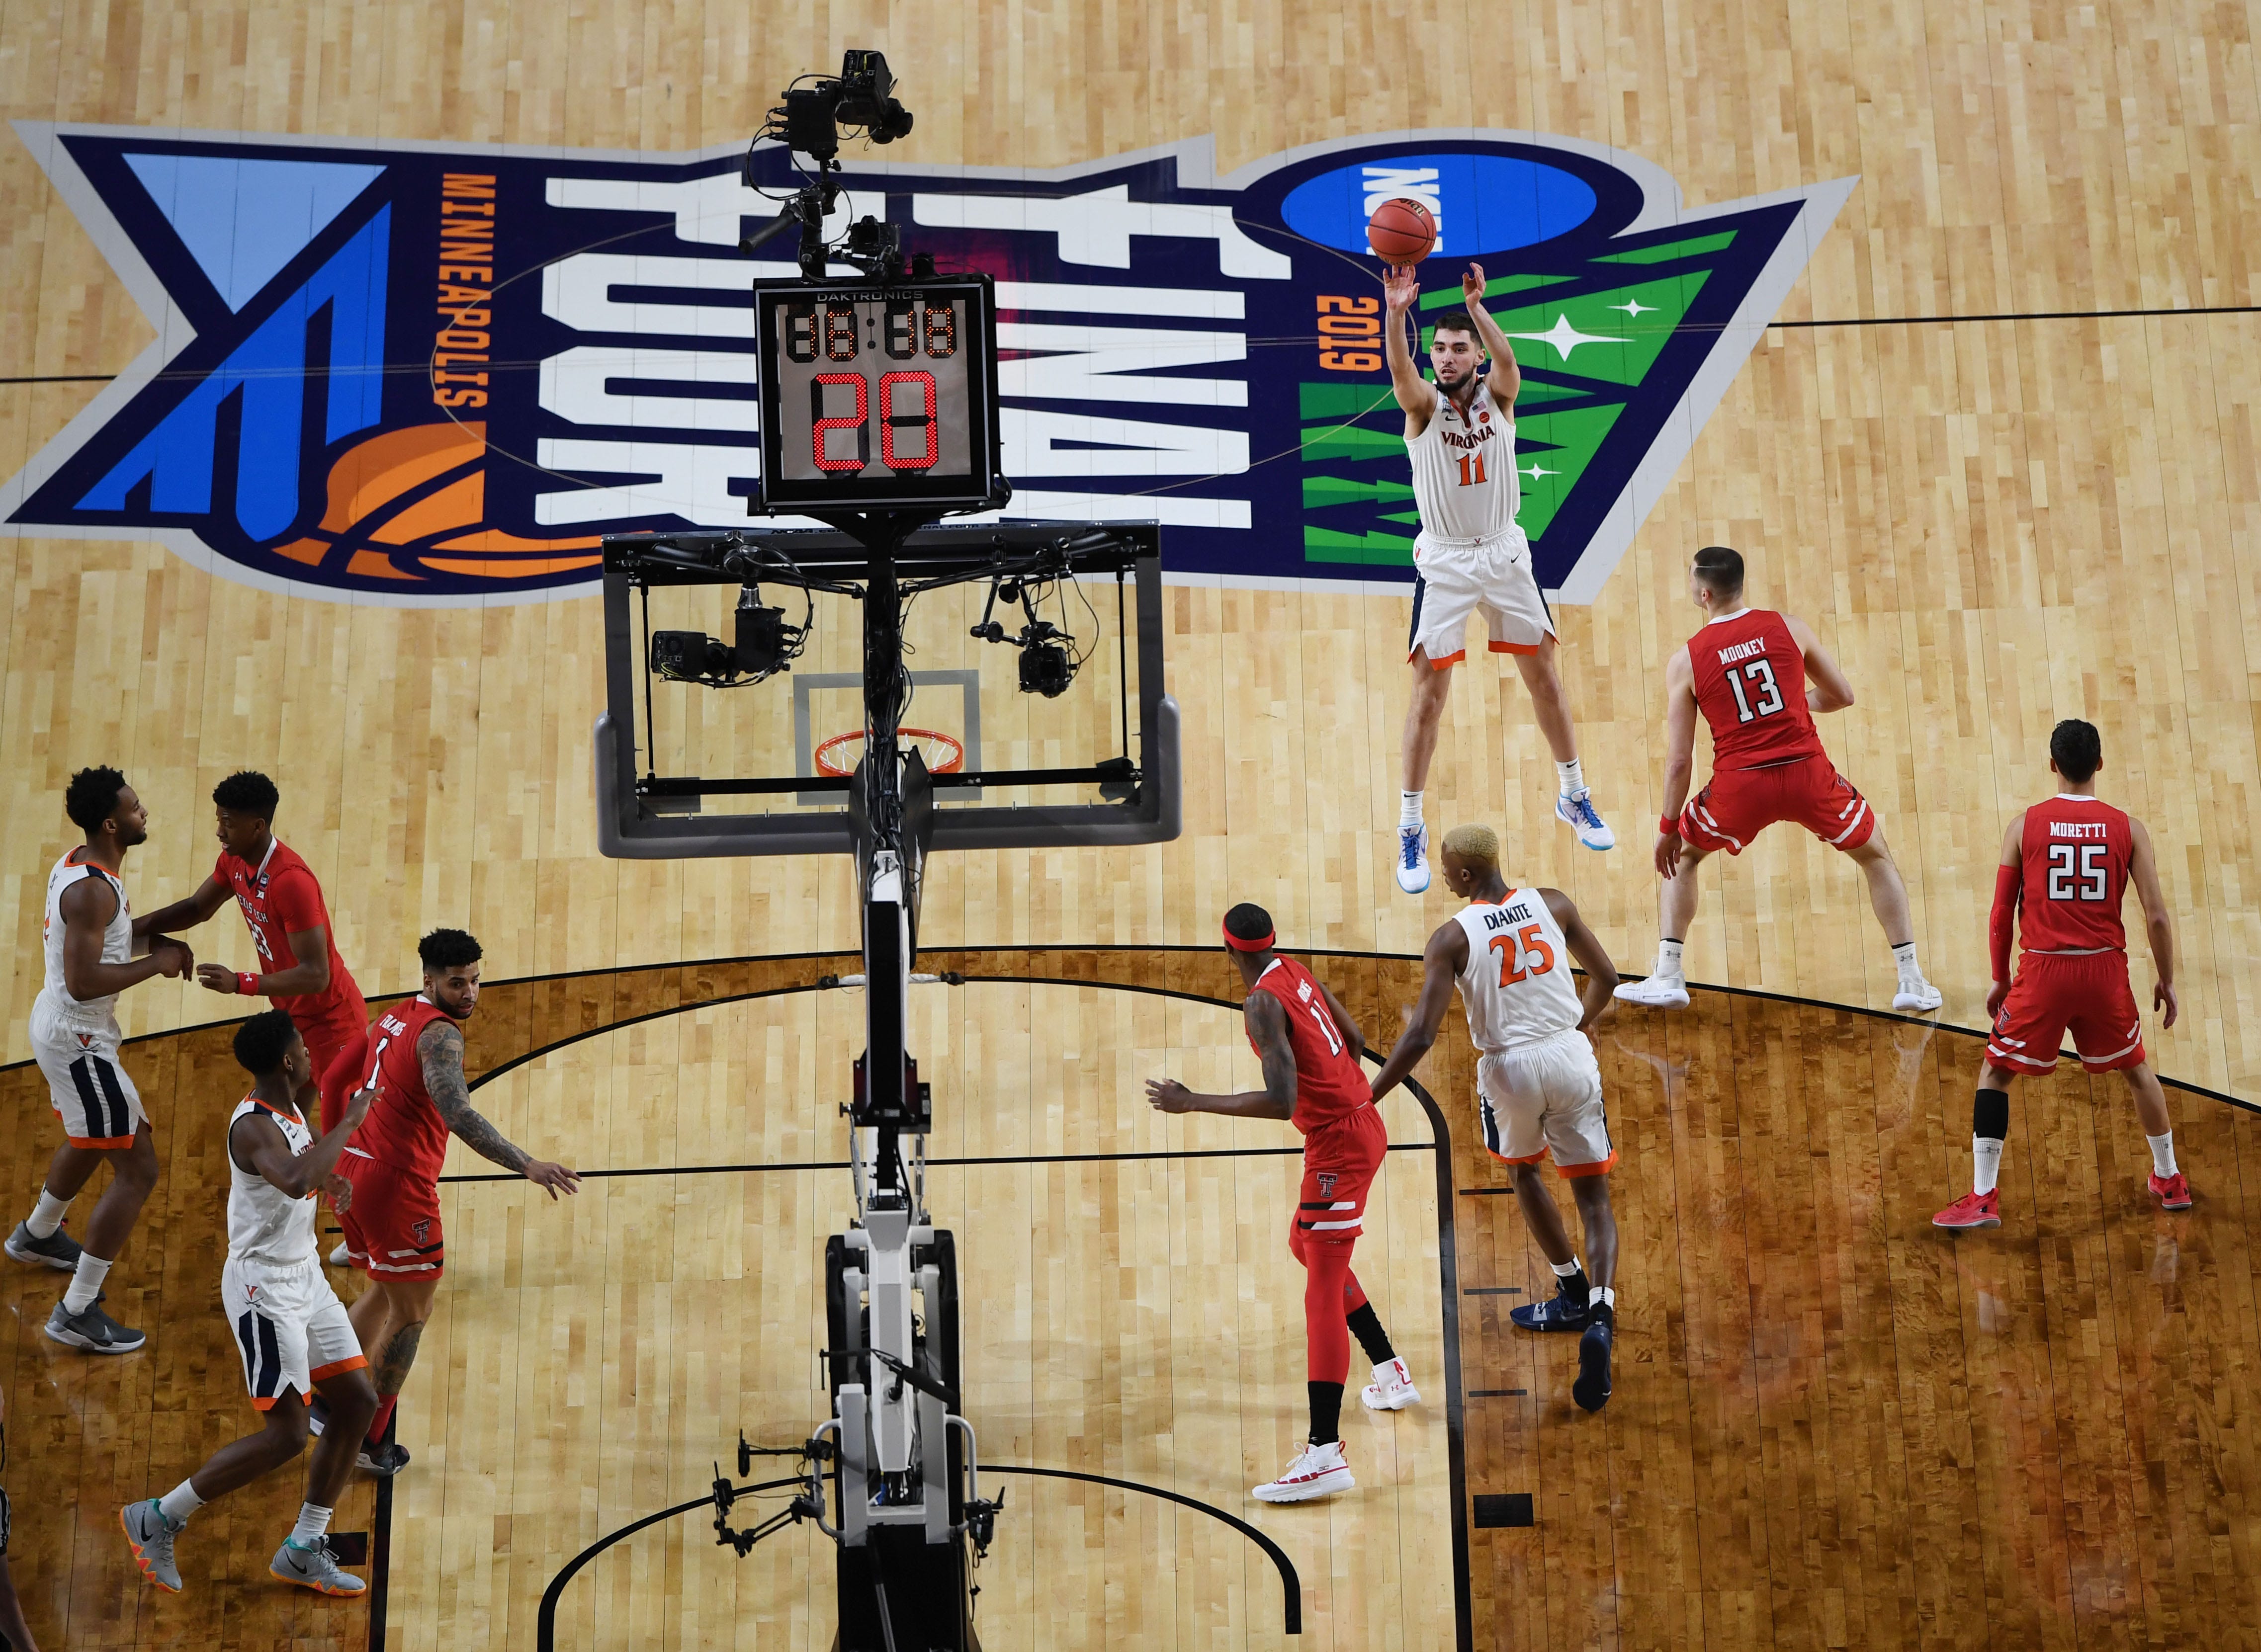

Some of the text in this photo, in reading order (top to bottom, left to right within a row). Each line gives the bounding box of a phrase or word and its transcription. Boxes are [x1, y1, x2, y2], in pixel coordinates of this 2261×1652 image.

[433, 173, 497, 410] MINNEAPOLIS
[816, 291, 924, 302] DAKTRONICS
[913, 184, 1292, 529] FINAL
[1316, 295, 1383, 372] 2019
[812, 370, 939, 471] 20
[1441, 425, 1496, 450] VIRGINIA
[1456, 449, 1488, 487] 11
[1717, 636, 1766, 665] MOONEY
[1726, 657, 1785, 724] 13
[2049, 822, 2107, 838] MORETTI
[2047, 843, 2108, 902] 25
[1483, 903, 1533, 931] DIAKITE
[1488, 923, 1555, 989] 25
[365, 1035, 389, 1090] 1
